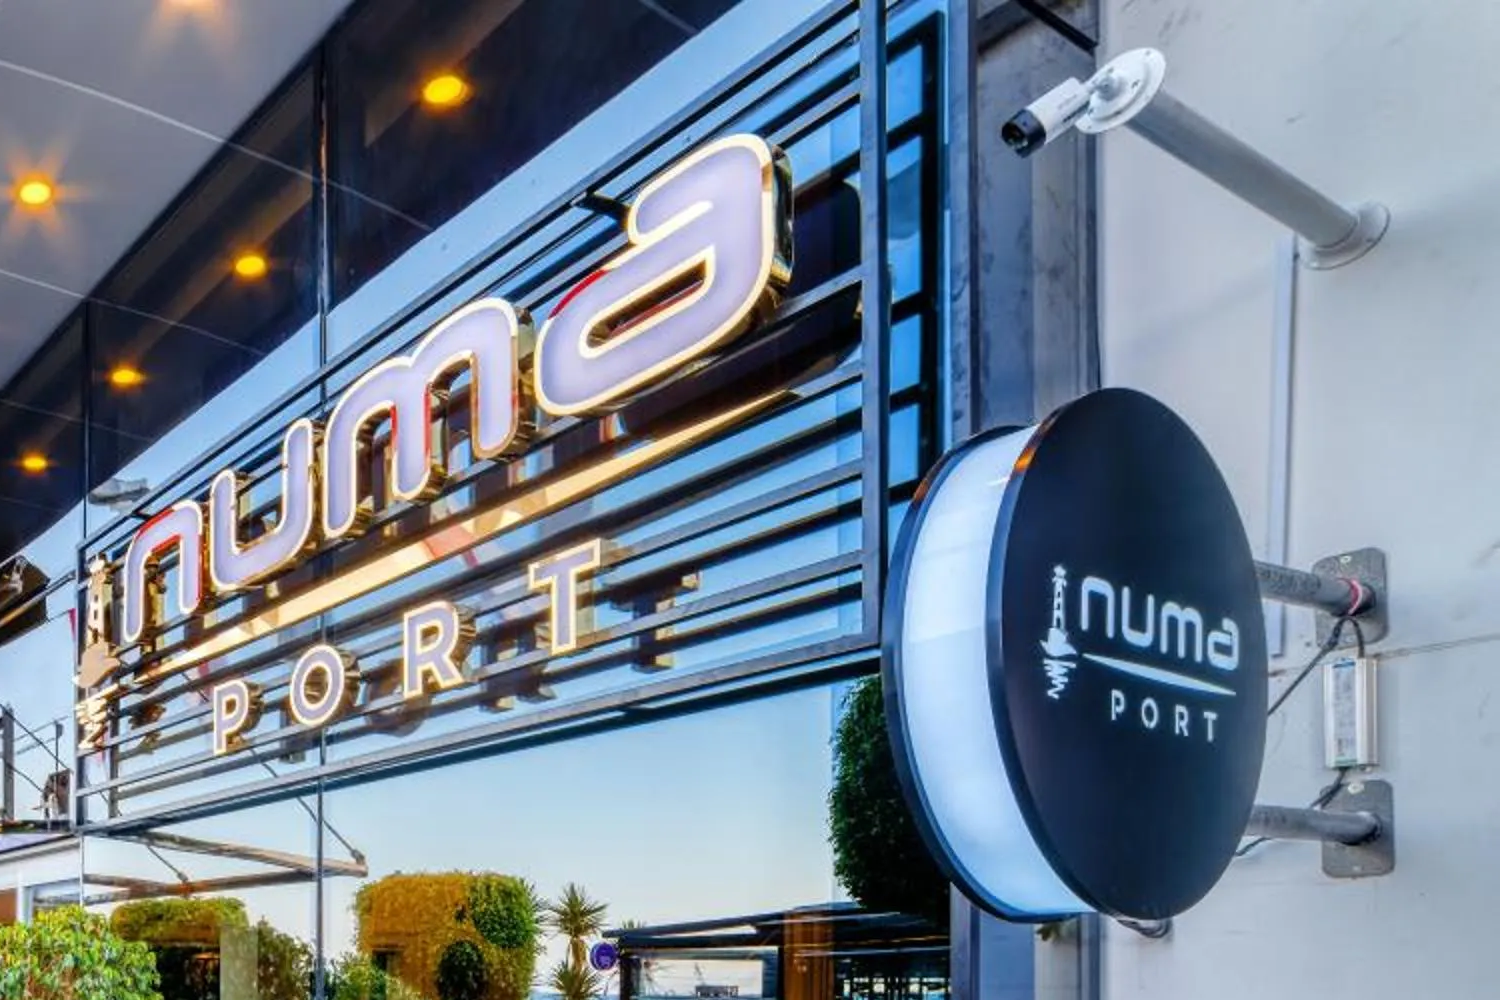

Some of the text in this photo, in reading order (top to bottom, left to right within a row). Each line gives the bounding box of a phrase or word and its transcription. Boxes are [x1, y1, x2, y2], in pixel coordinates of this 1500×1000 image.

[122, 133, 777, 645] numa
[212, 538, 602, 756] PORT
[1080, 576, 1240, 671] numa
[1110, 688, 1219, 743] PORT
